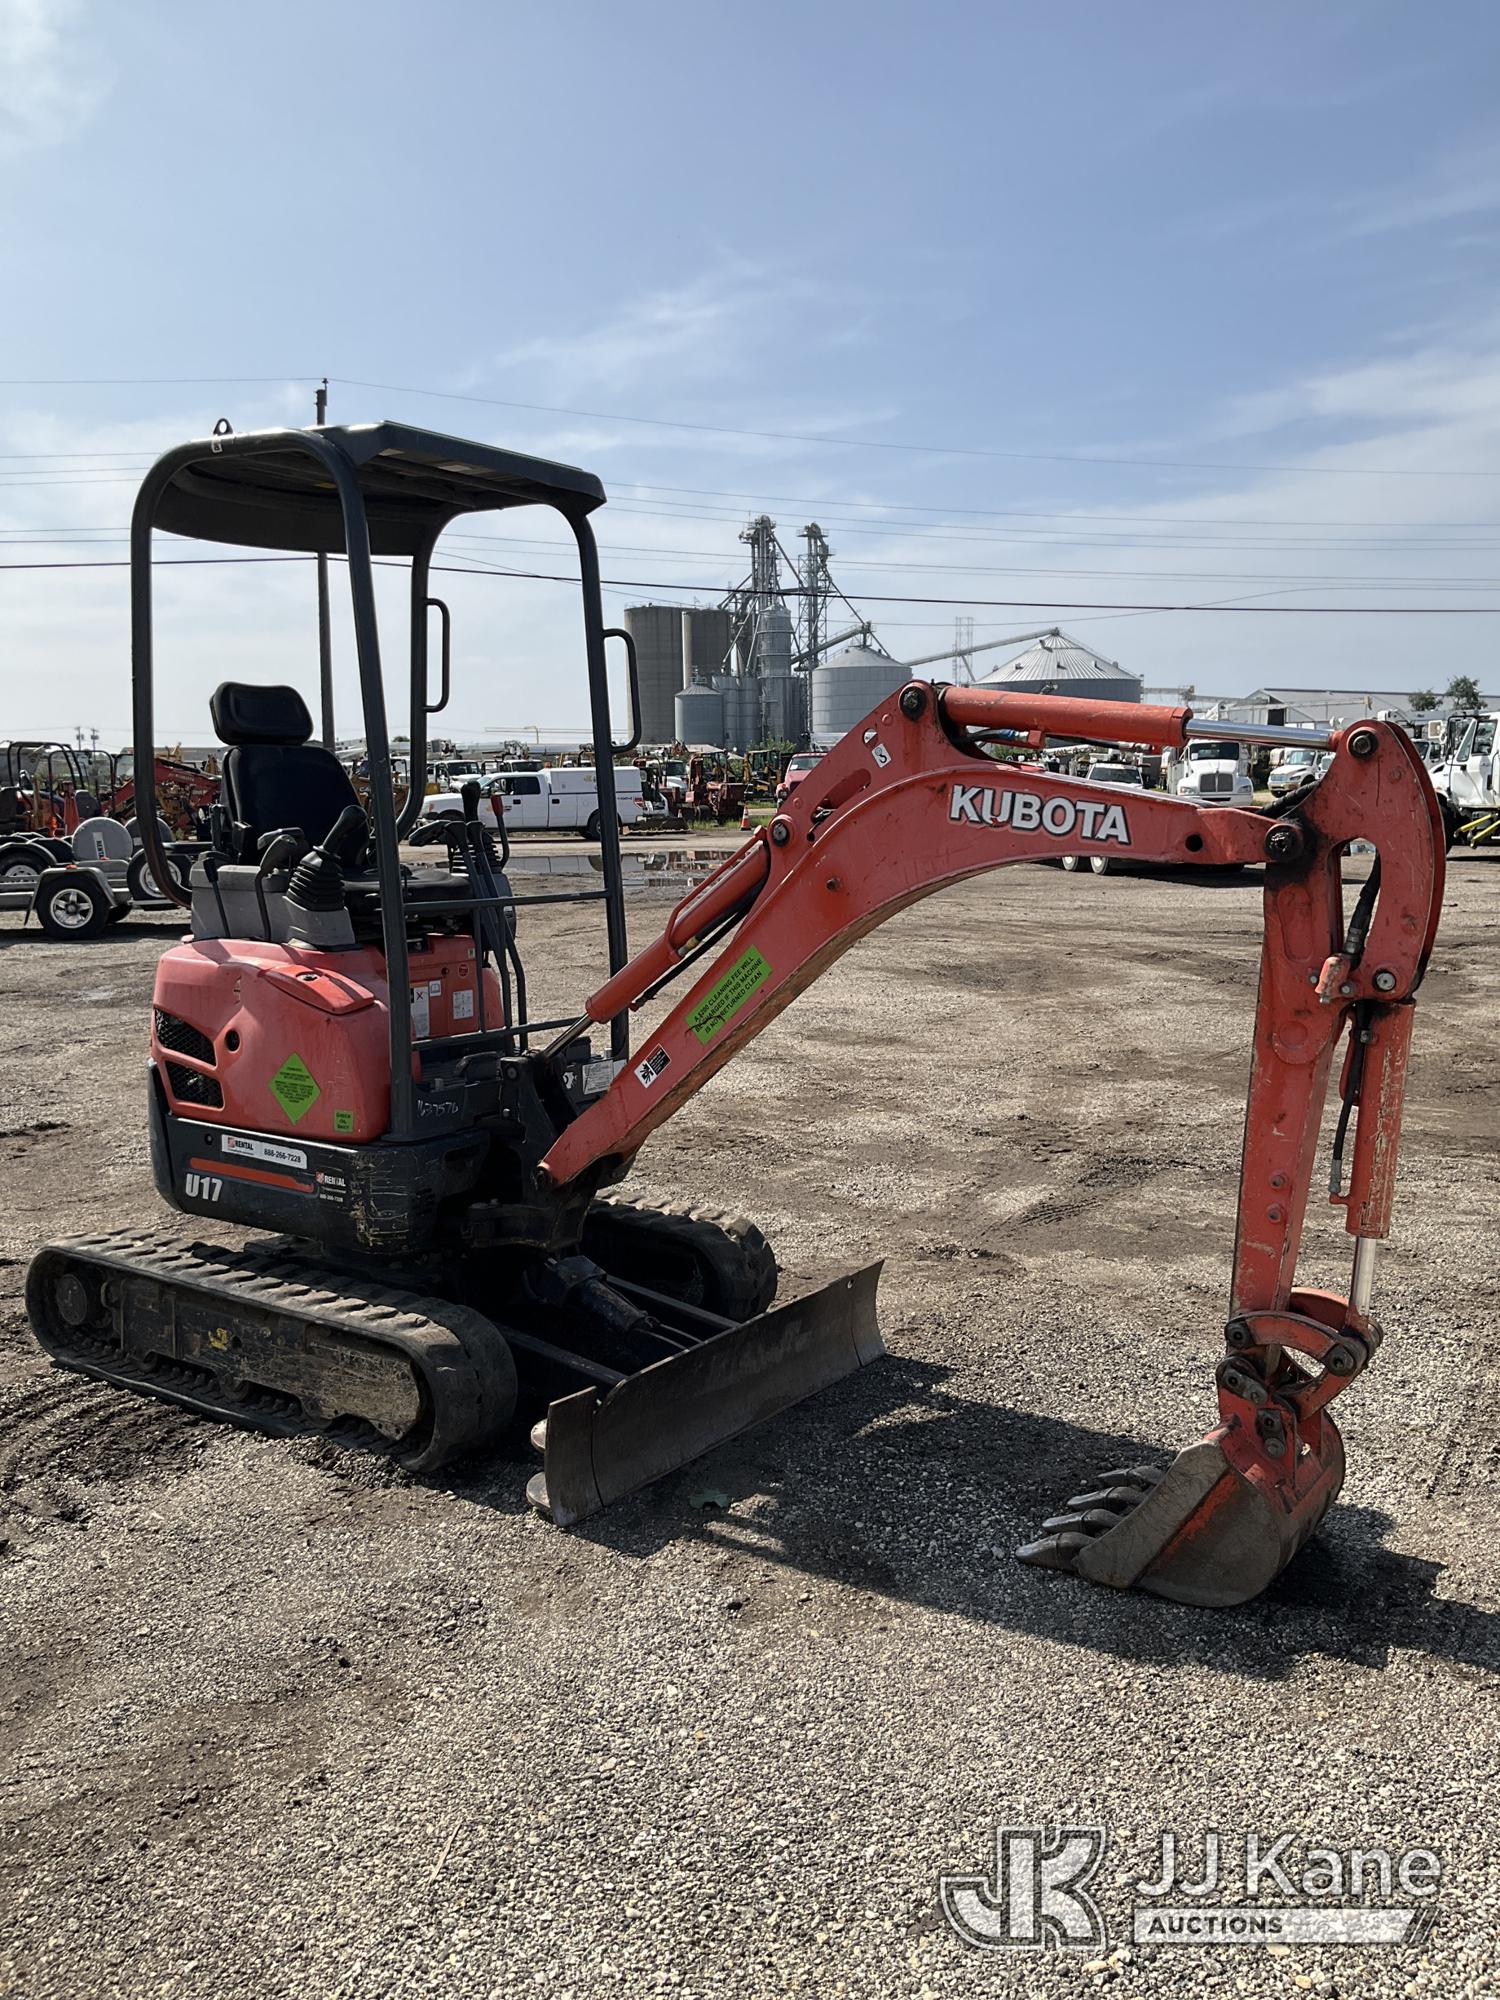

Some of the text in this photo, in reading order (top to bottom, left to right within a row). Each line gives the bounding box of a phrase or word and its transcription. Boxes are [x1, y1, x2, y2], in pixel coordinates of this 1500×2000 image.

[949, 784, 1131, 845] KUBOTA
[708, 979, 732, 1006] CLEANING
[732, 968, 742, 981] FEE
[741, 957, 754, 970] WILL
[729, 982, 741, 997] THIS
[740, 958, 763, 983] MACHINE
[745, 971, 763, 990] CLEAN
[235, 1140, 254, 1151] RENTAL
[185, 1173, 223, 1202] U17
